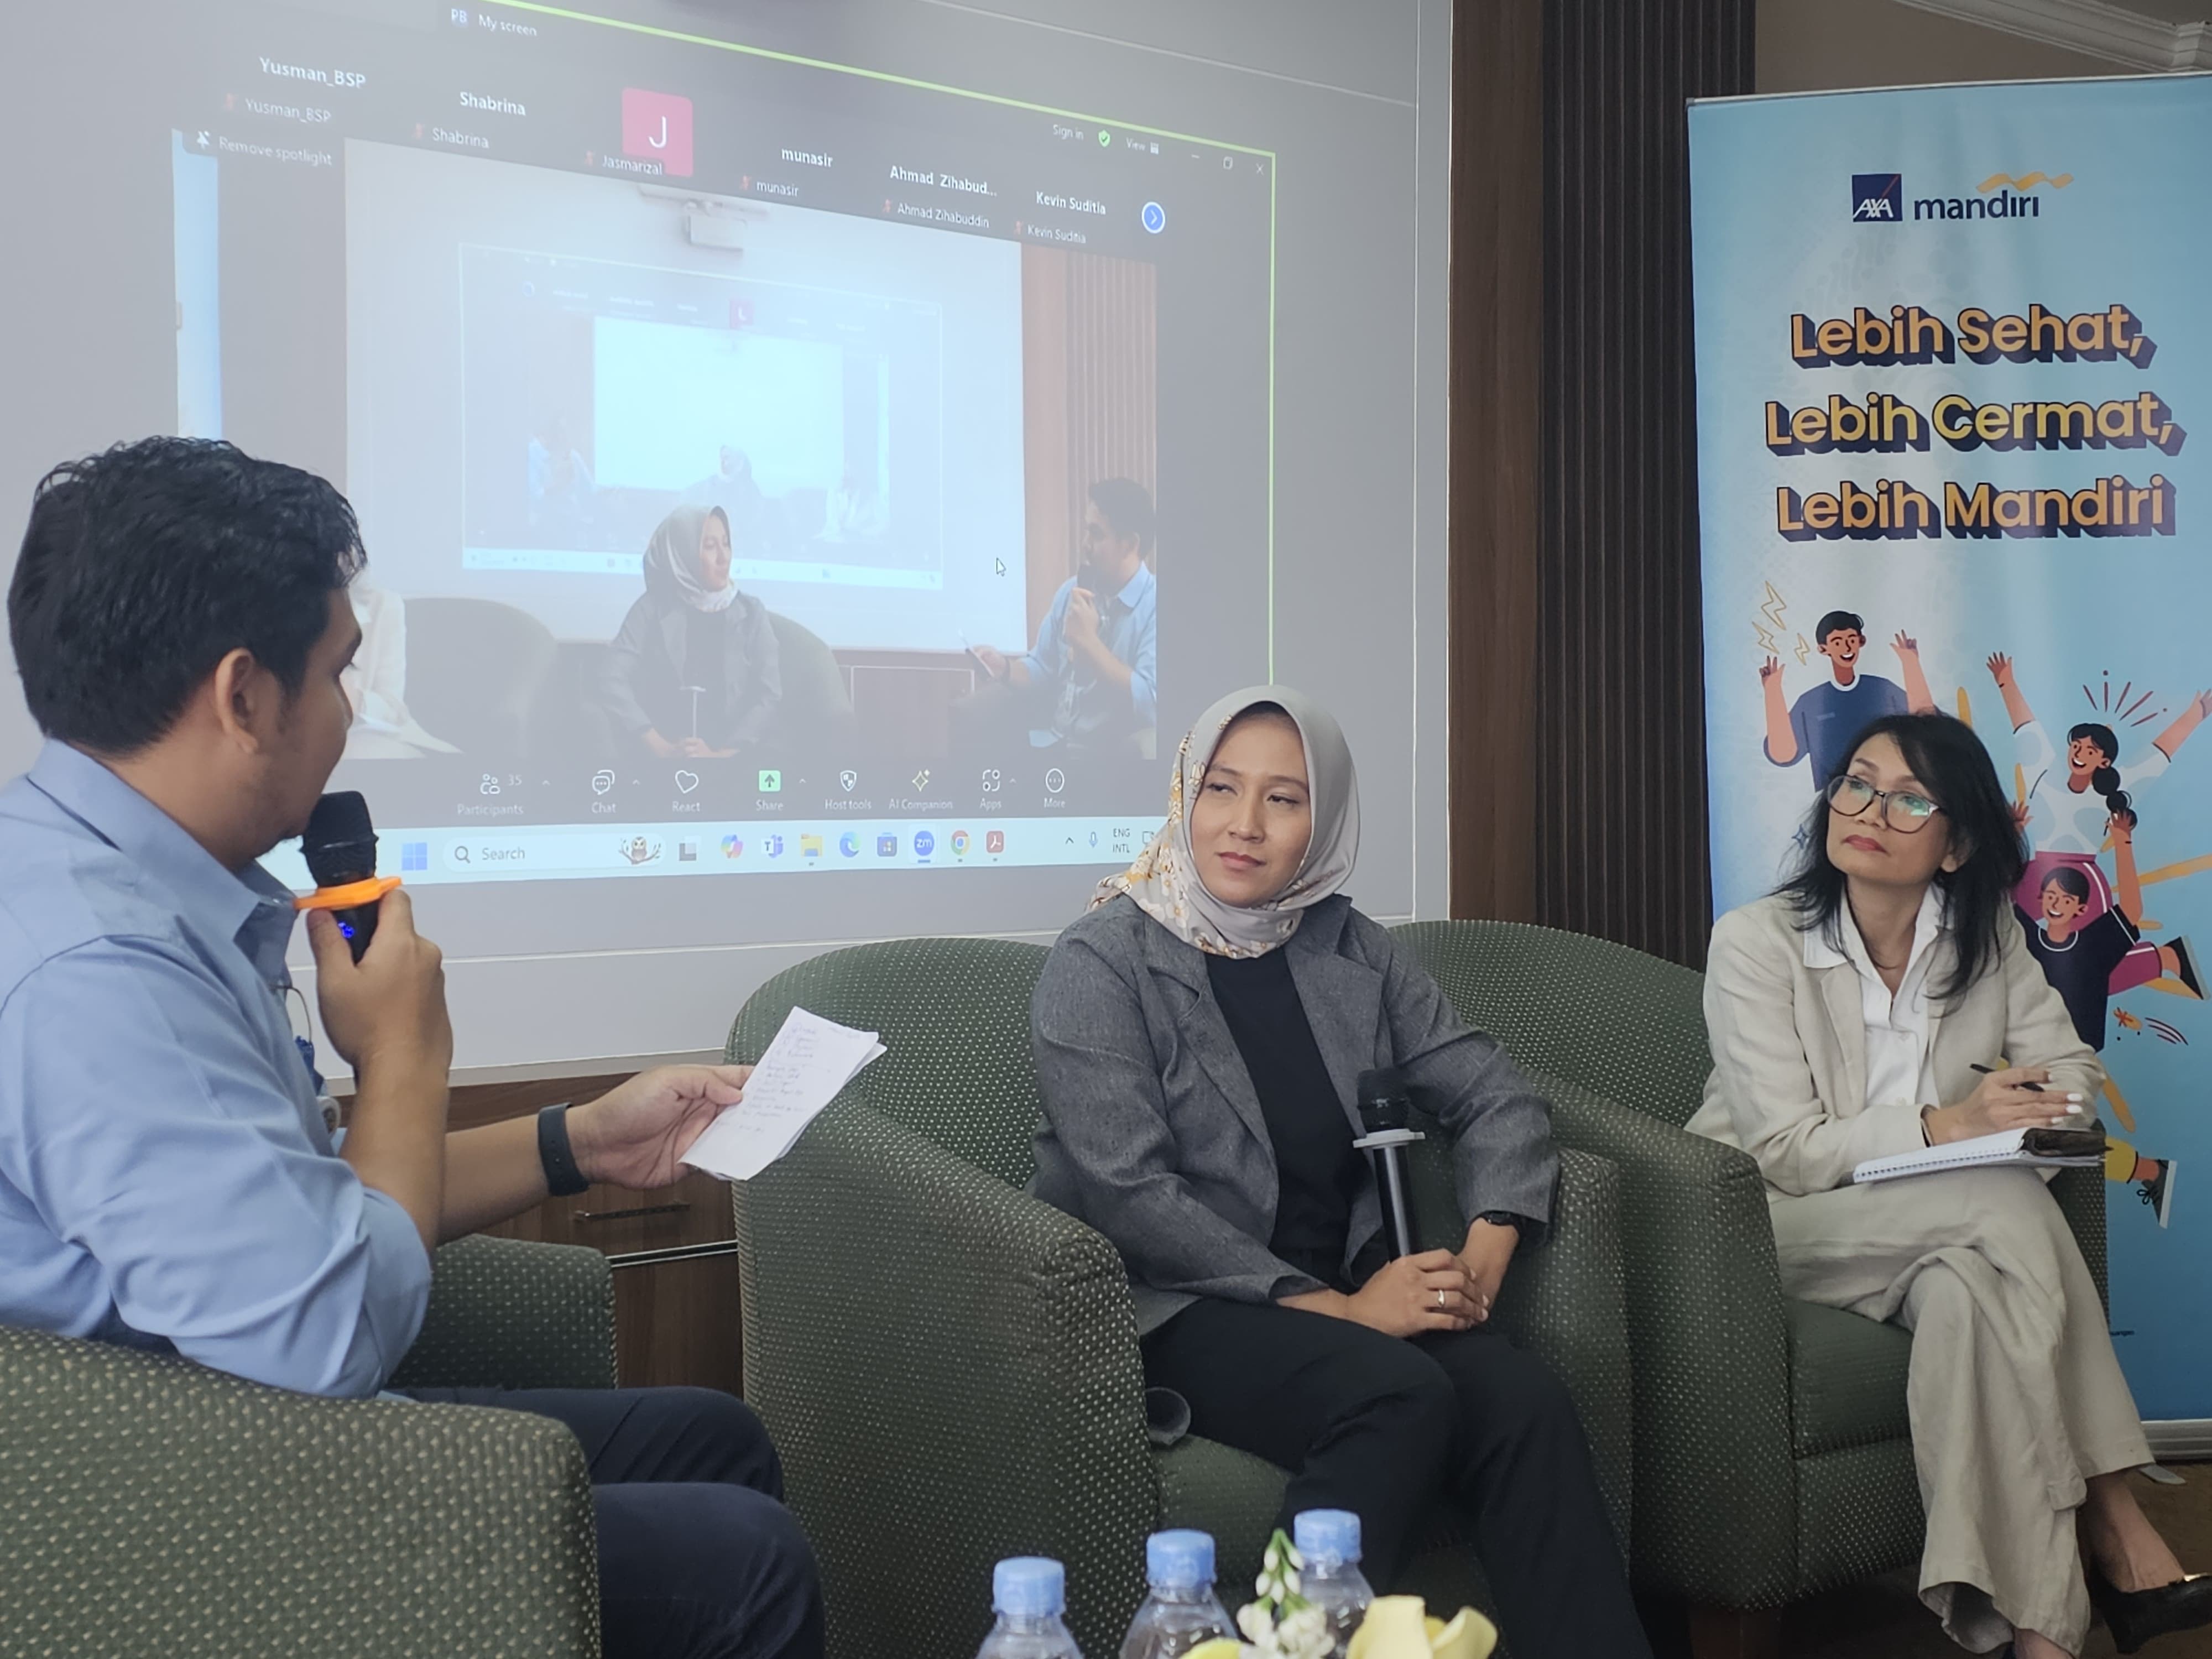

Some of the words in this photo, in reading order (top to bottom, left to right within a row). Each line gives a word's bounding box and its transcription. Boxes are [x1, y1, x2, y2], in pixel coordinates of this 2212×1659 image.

[450, 8, 468, 23] PB
[478, 13, 498, 32] My
[499, 20, 538, 36] screen
[258, 56, 367, 88] Yusman_BSP
[245, 97, 332, 123] Yusman_BSP
[459, 91, 526, 116] Shabrina
[432, 127, 489, 149] Shabrina
[648, 115, 668, 148] J
[1052, 124, 1073, 140] Sign
[1074, 129, 1084, 140] in
[219, 136, 273, 158] Remove
[275, 148, 332, 167] spotlight
[1126, 137, 1146, 152] View
[602, 155, 663, 176] Jasmarizal
[781, 147, 833, 168] munasir
[890, 165, 933, 186] Ahmad
[940, 174, 998, 197] Zihabud...
[757, 181, 799, 198] munasir
[1036, 191, 1067, 208] Kevin
[1069, 196, 1106, 216] Suditia
[1853, 197, 1895, 220] AXA
[1913, 189, 2041, 221] mandiri
[898, 202, 933, 220] Ahmad
[935, 208, 990, 228] Zihabuddin
[1027, 224, 1053, 239] Kevin
[1791, 305, 1956, 369] Lebih
[1957, 304, 2157, 369] Sehat,
[1765, 392, 1931, 457] Lebih
[1932, 392, 2188, 457] Cermat,
[1777, 478, 1942, 542] Lebih
[1944, 473, 2177, 540] Mandiri
[508, 775, 523, 786] 35
[457, 802, 524, 817] Participants
[591, 801, 617, 814] Chat
[672, 801, 701, 813] React
[756, 799, 784, 812] Share
[825, 799, 847, 811] Host
[849, 799, 872, 811] tools
[889, 799, 899, 810] AI
[900, 799, 953, 812] Companion
[979, 798, 1002, 811] Apps
[1044, 797, 1066, 809] More
[1113, 828, 1131, 838] ENG
[916, 838, 933, 848] zm
[1113, 844, 1130, 853] INTL
[482, 846, 525, 861] Search
